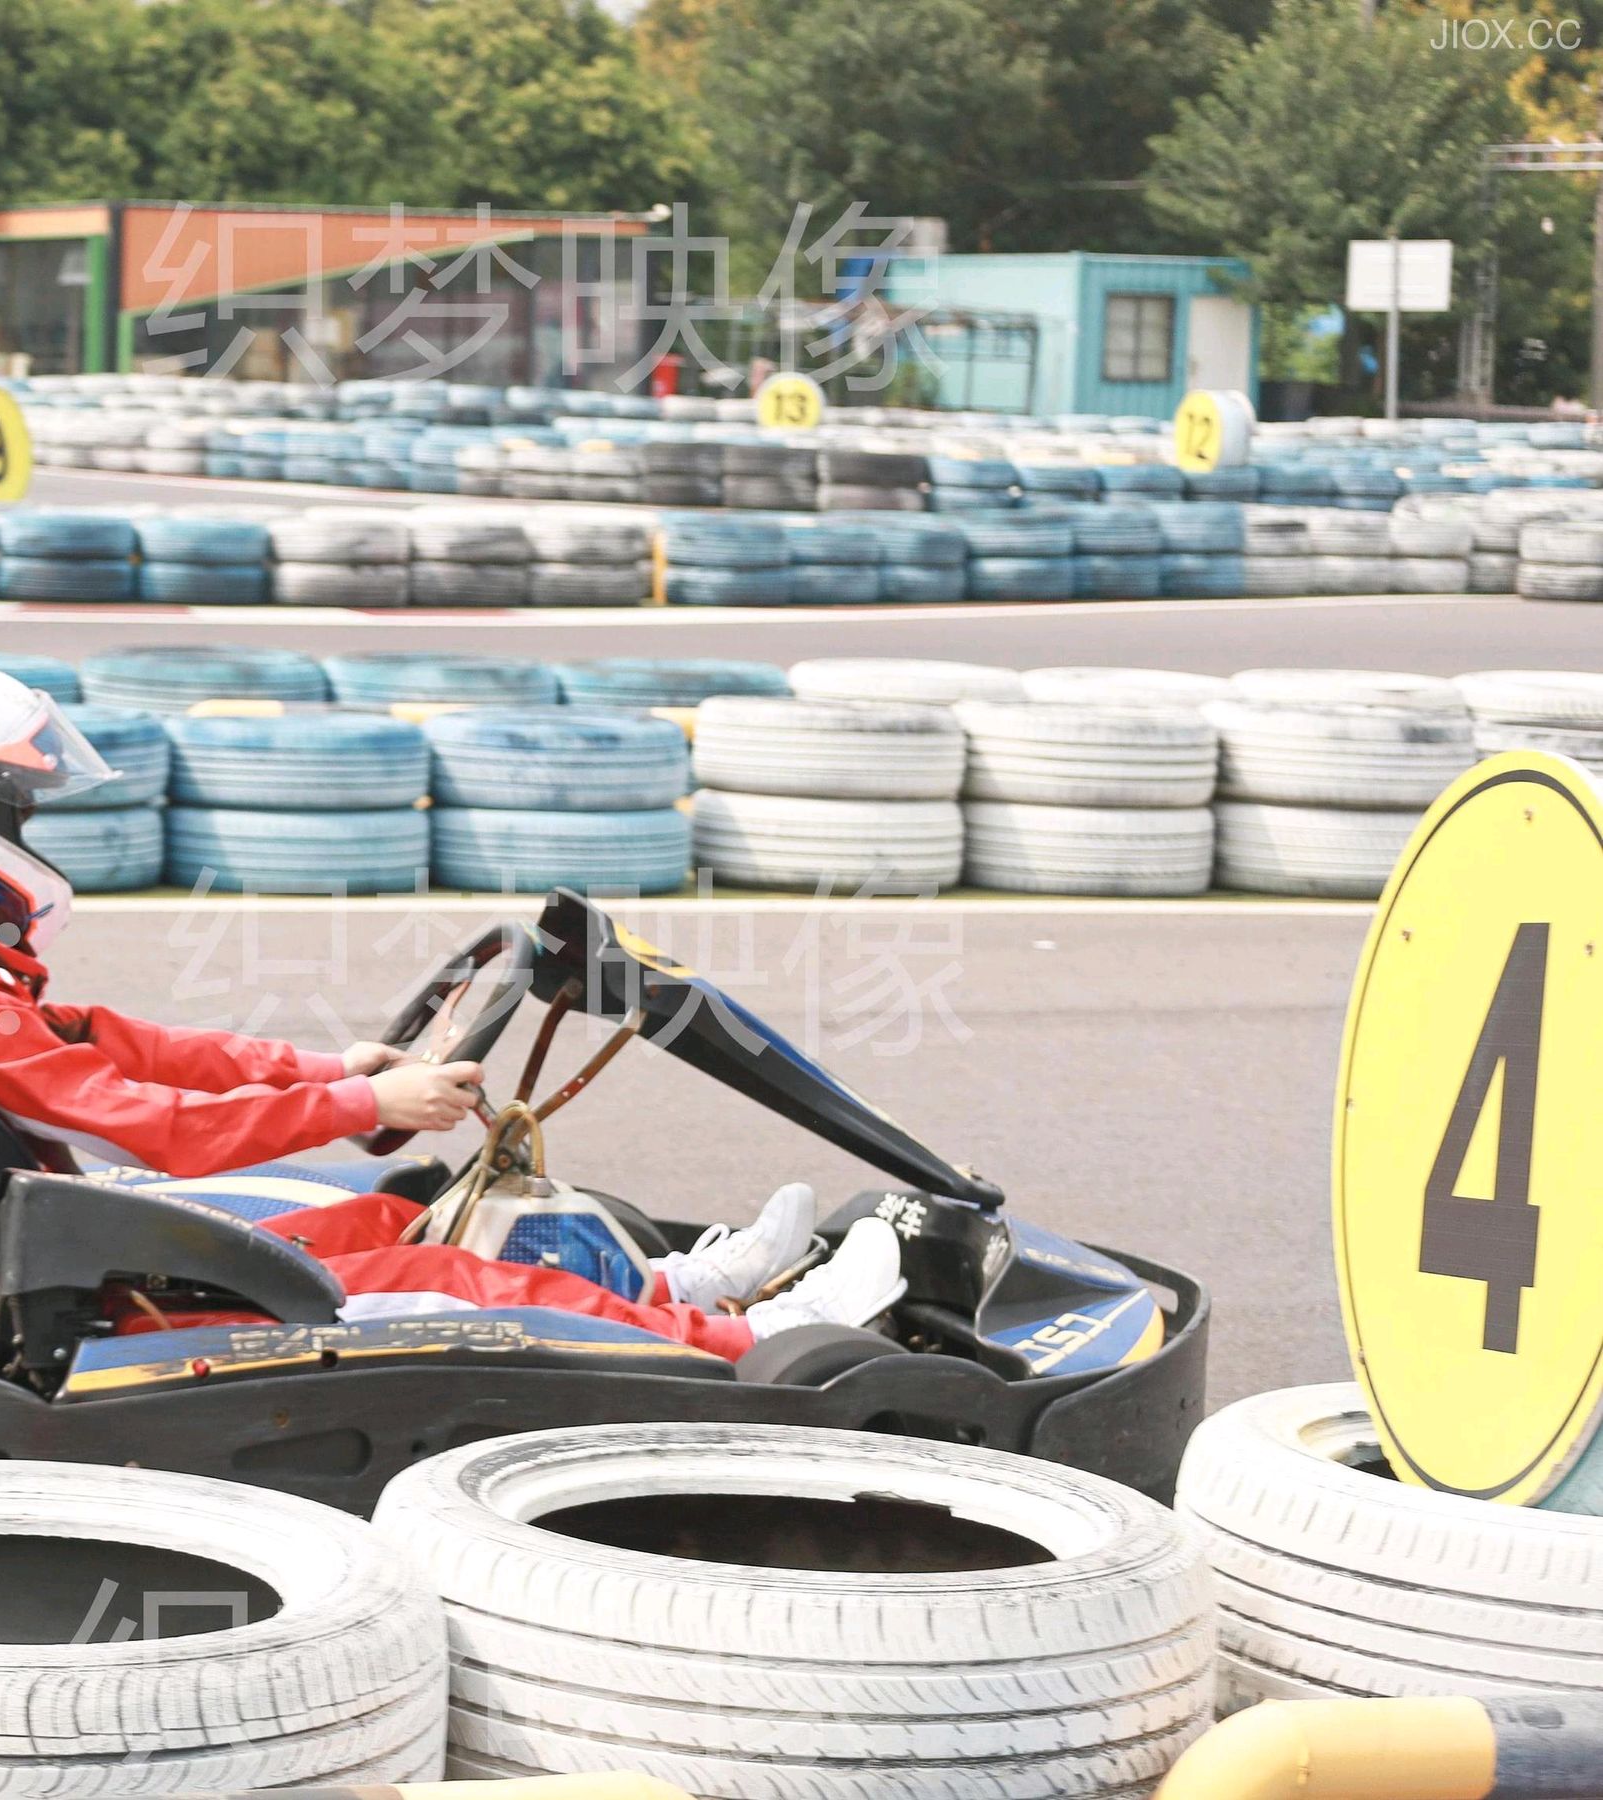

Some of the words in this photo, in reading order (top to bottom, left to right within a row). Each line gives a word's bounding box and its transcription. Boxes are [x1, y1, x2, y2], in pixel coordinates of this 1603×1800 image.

[774, 393, 807, 423] 13
[1185, 412, 1213, 462] 12
[1419, 922, 1550, 1355] 4
